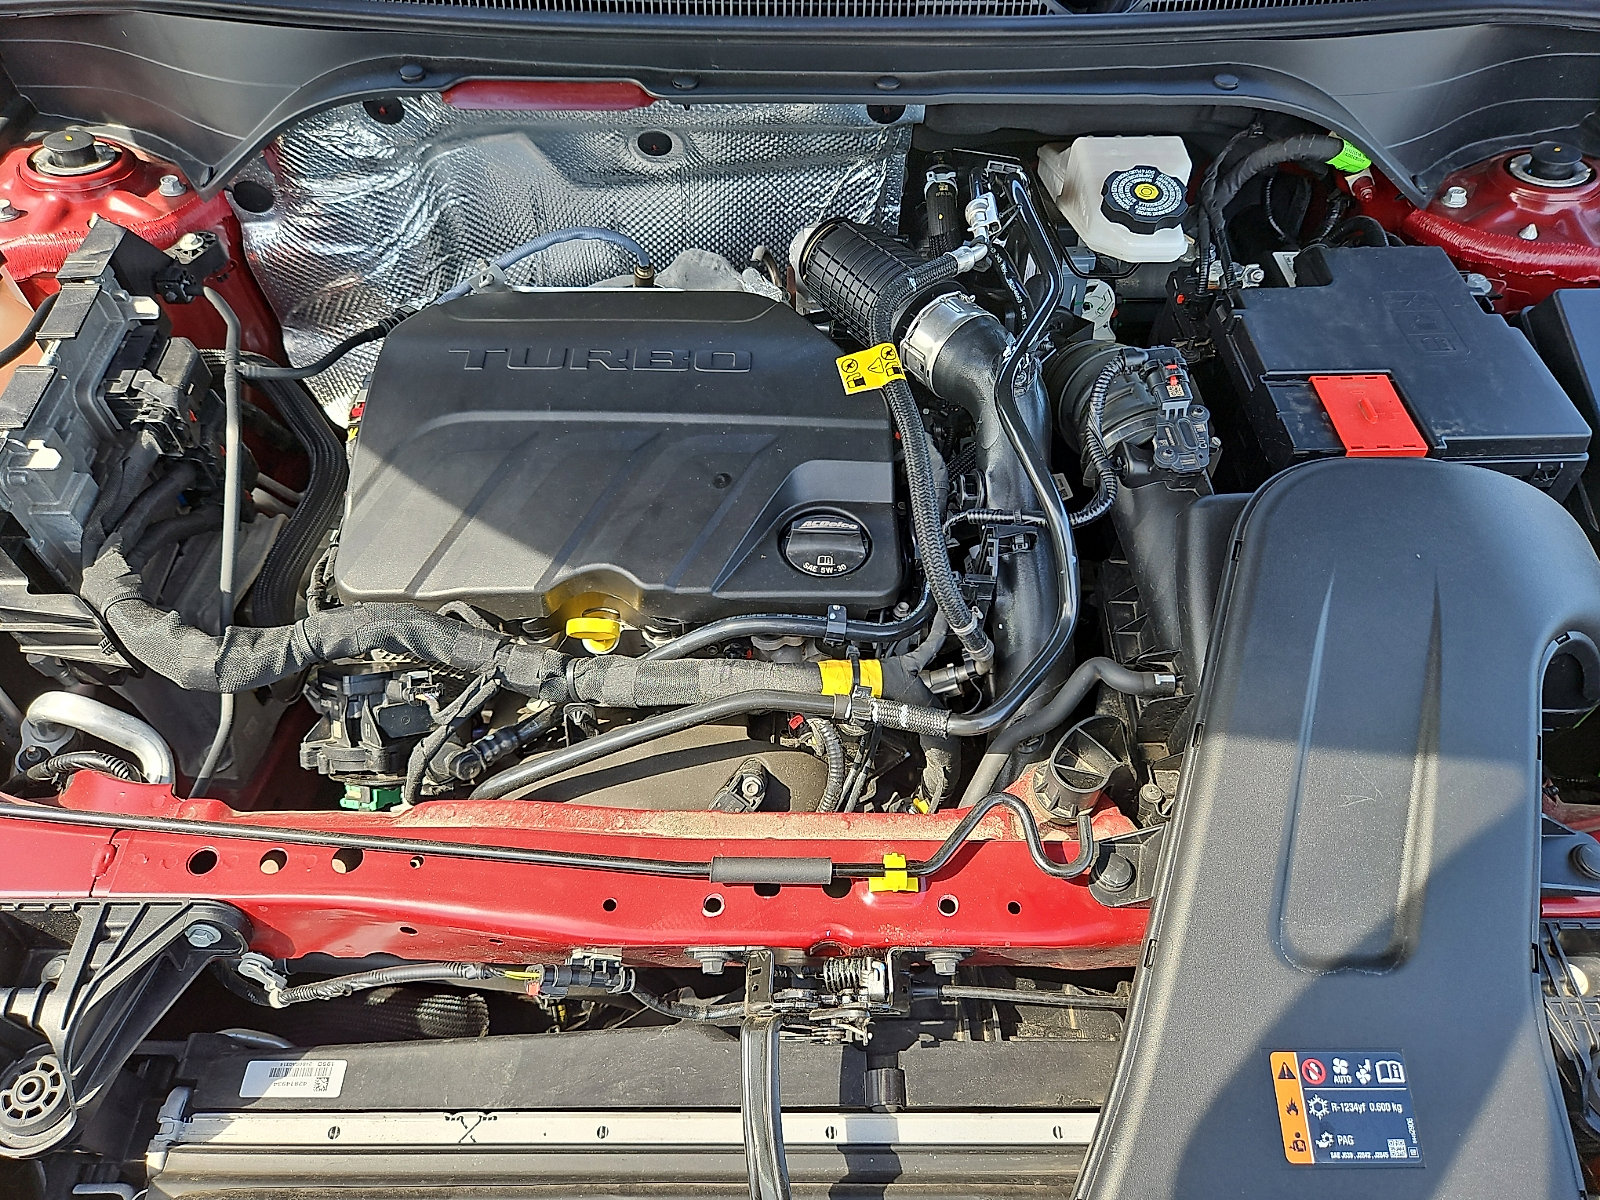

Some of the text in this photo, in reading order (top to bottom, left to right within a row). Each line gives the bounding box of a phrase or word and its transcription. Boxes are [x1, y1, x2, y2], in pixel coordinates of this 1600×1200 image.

[448, 347, 753, 373] TURBO
[799, 520, 858, 529] ACDelco
[802, 562, 847, 574] SAE 5W-30
[1334, 1075, 1352, 1084] AUTO
[1330, 1102, 1402, 1114] R-1234yf 0.600 kg
[1336, 1134, 1354, 1146] PAG
